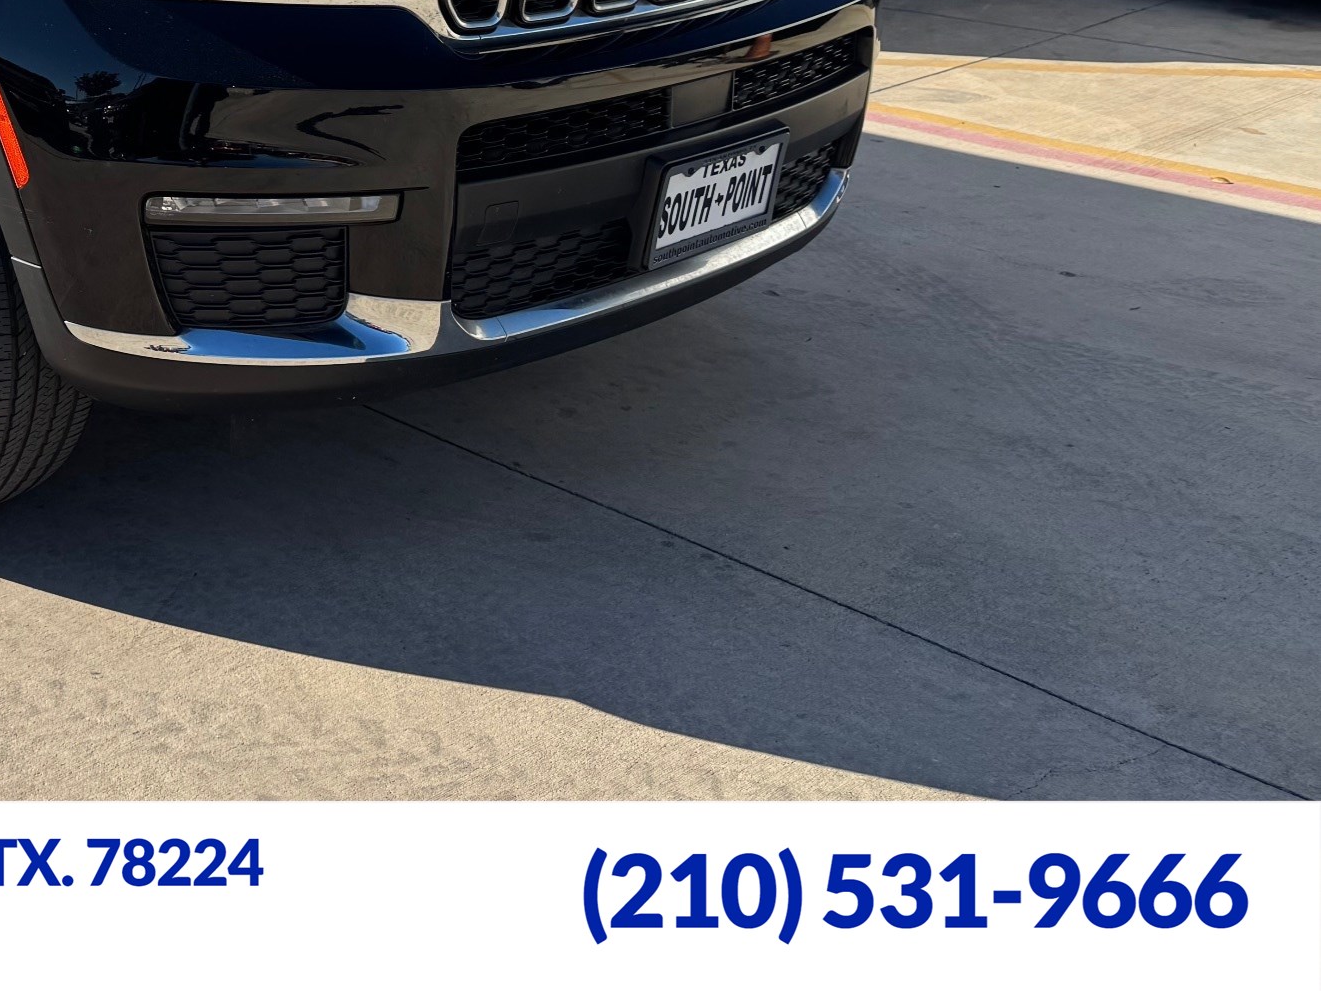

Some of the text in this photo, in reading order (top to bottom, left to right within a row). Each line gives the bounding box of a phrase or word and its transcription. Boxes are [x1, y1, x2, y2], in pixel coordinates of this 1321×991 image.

[702, 154, 747, 179] TEXAS
[658, 163, 774, 240] SOUTH POINT
[652, 218, 768, 265] southpointautomotive.com
